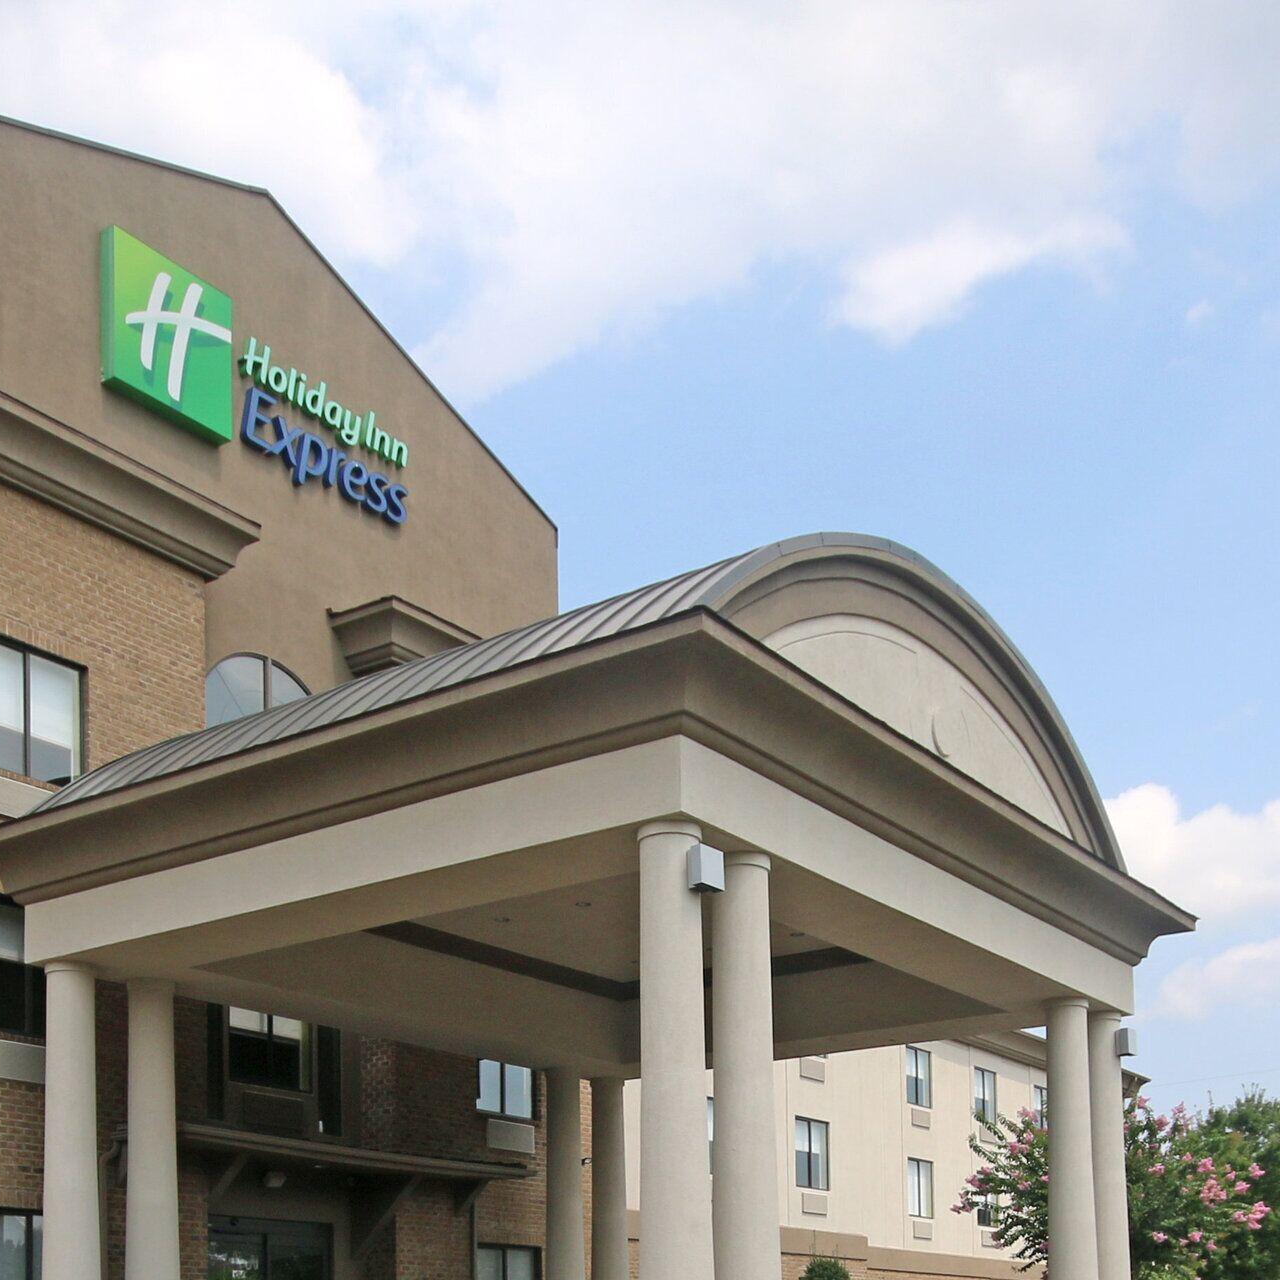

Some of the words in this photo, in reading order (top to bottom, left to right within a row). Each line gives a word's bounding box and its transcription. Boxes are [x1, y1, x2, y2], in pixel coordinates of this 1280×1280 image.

[125, 271, 232, 402] H
[239, 336, 363, 446] Holiday
[362, 410, 409, 468] Inn
[241, 386, 409, 525] Express
